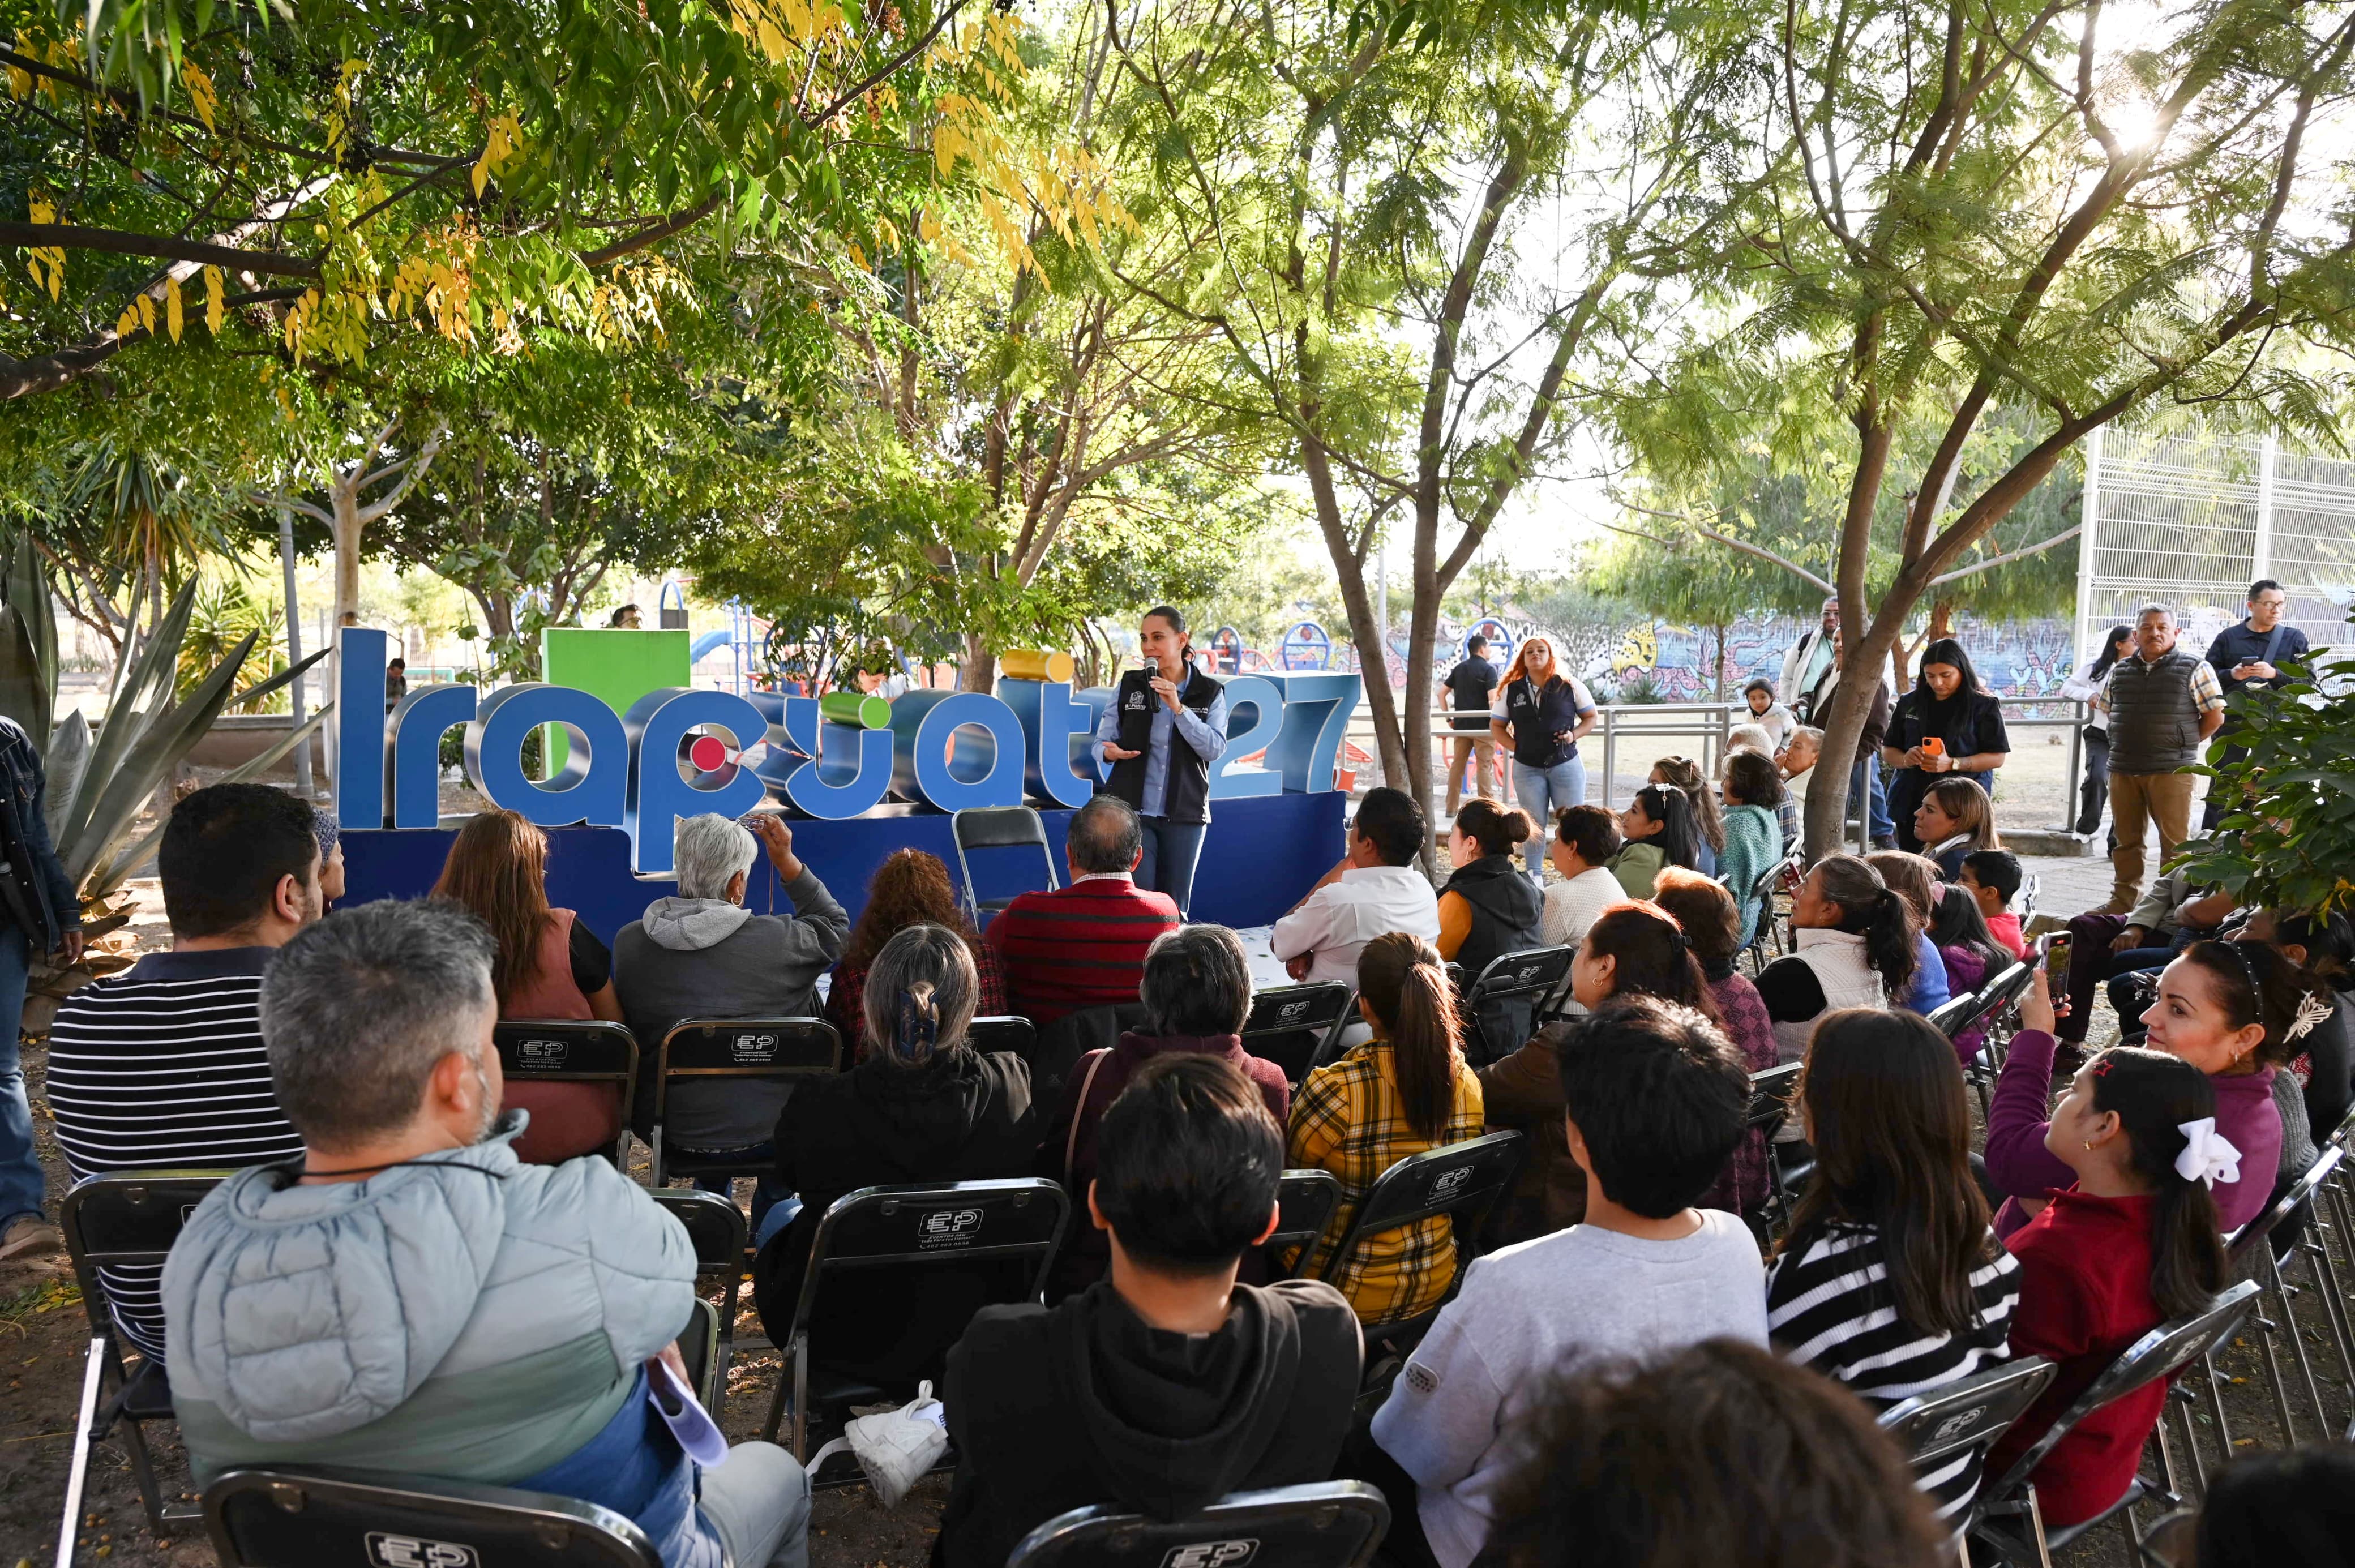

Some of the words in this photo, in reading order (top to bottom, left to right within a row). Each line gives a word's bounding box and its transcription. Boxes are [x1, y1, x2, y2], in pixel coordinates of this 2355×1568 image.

[1209, 671, 1361, 800] 27
[1281, 1002, 1307, 1017] EP
[524, 1042, 563, 1056] EP
[737, 1035, 774, 1049] EP
[1436, 1168, 1470, 1190] EP
[927, 1211, 977, 1233] EP
[378, 1537, 468, 1568] EP
[1171, 1542, 1249, 1568] EP
